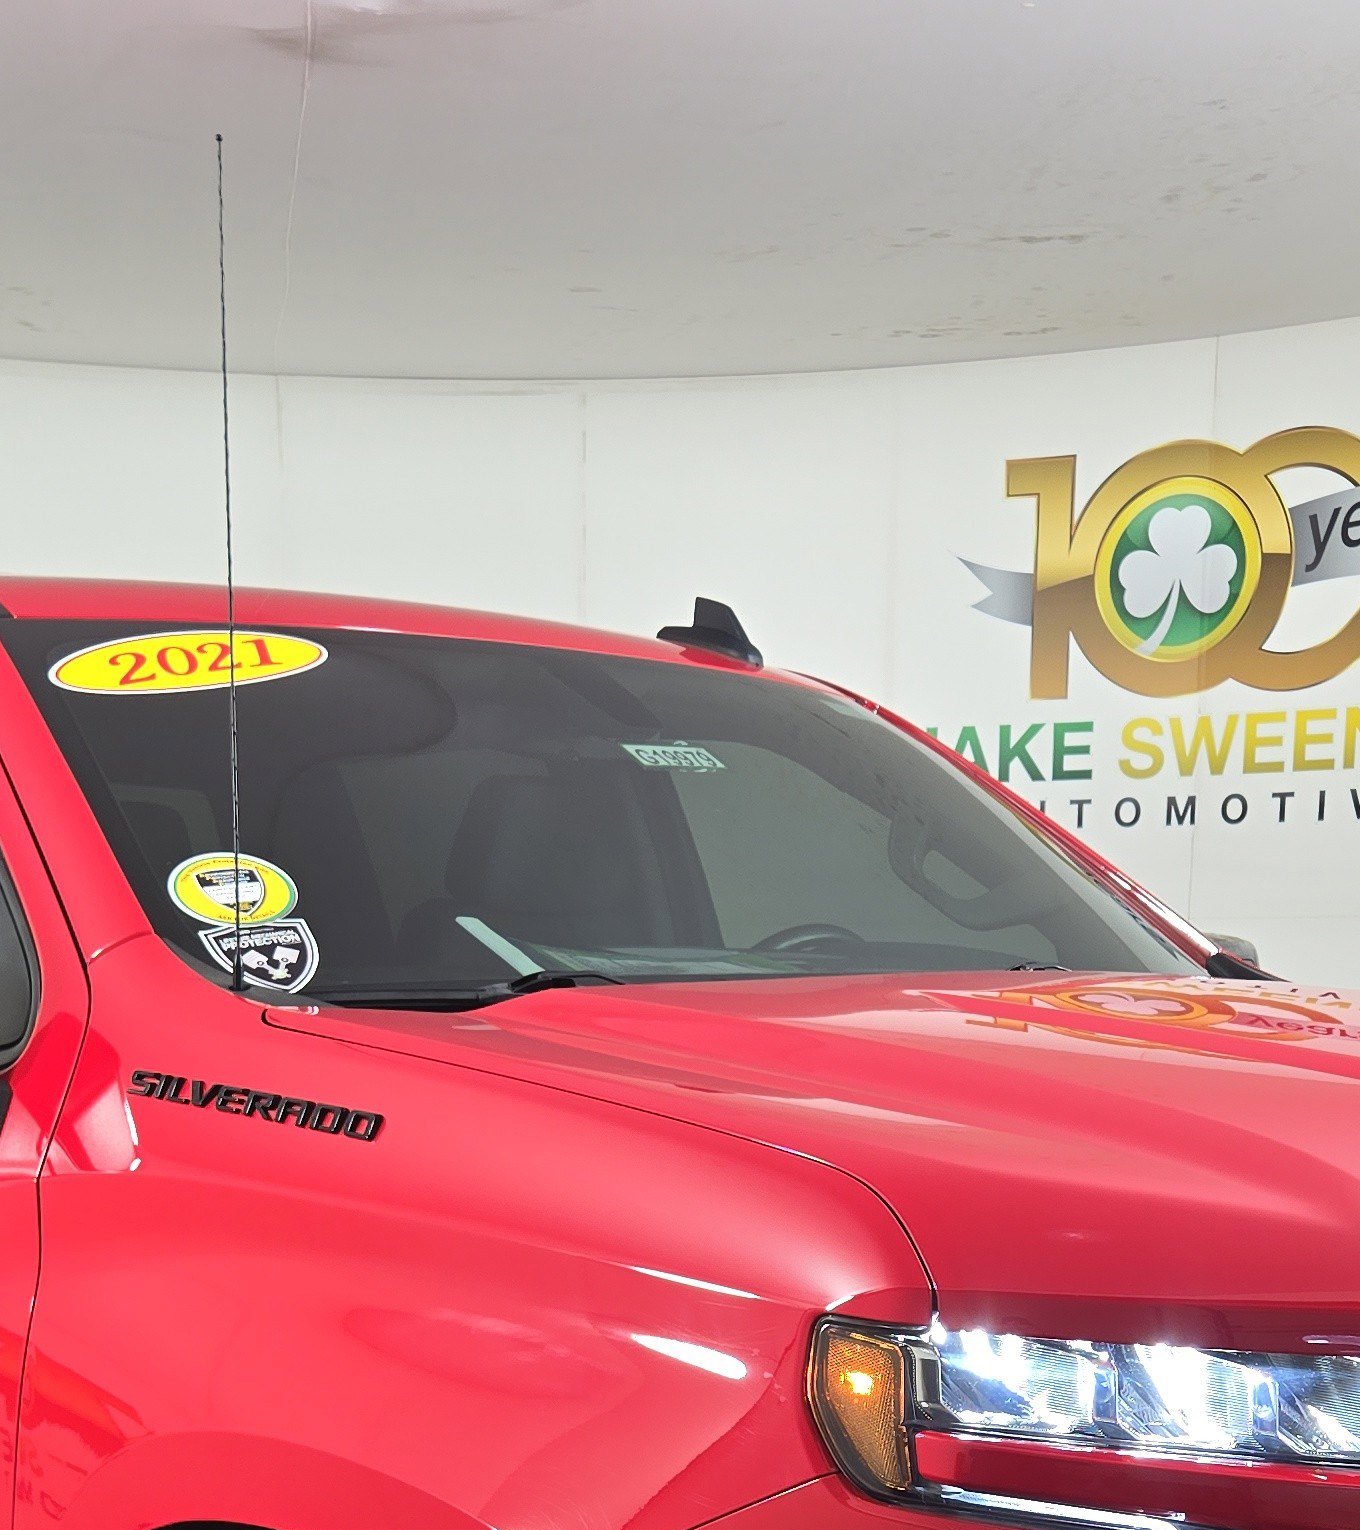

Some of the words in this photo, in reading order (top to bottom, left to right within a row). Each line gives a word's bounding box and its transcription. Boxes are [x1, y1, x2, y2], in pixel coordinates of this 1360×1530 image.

[108, 638, 283, 686] 2021
[926, 721, 1094, 783] AKE
[127, 1069, 388, 1143] SILVERADO
